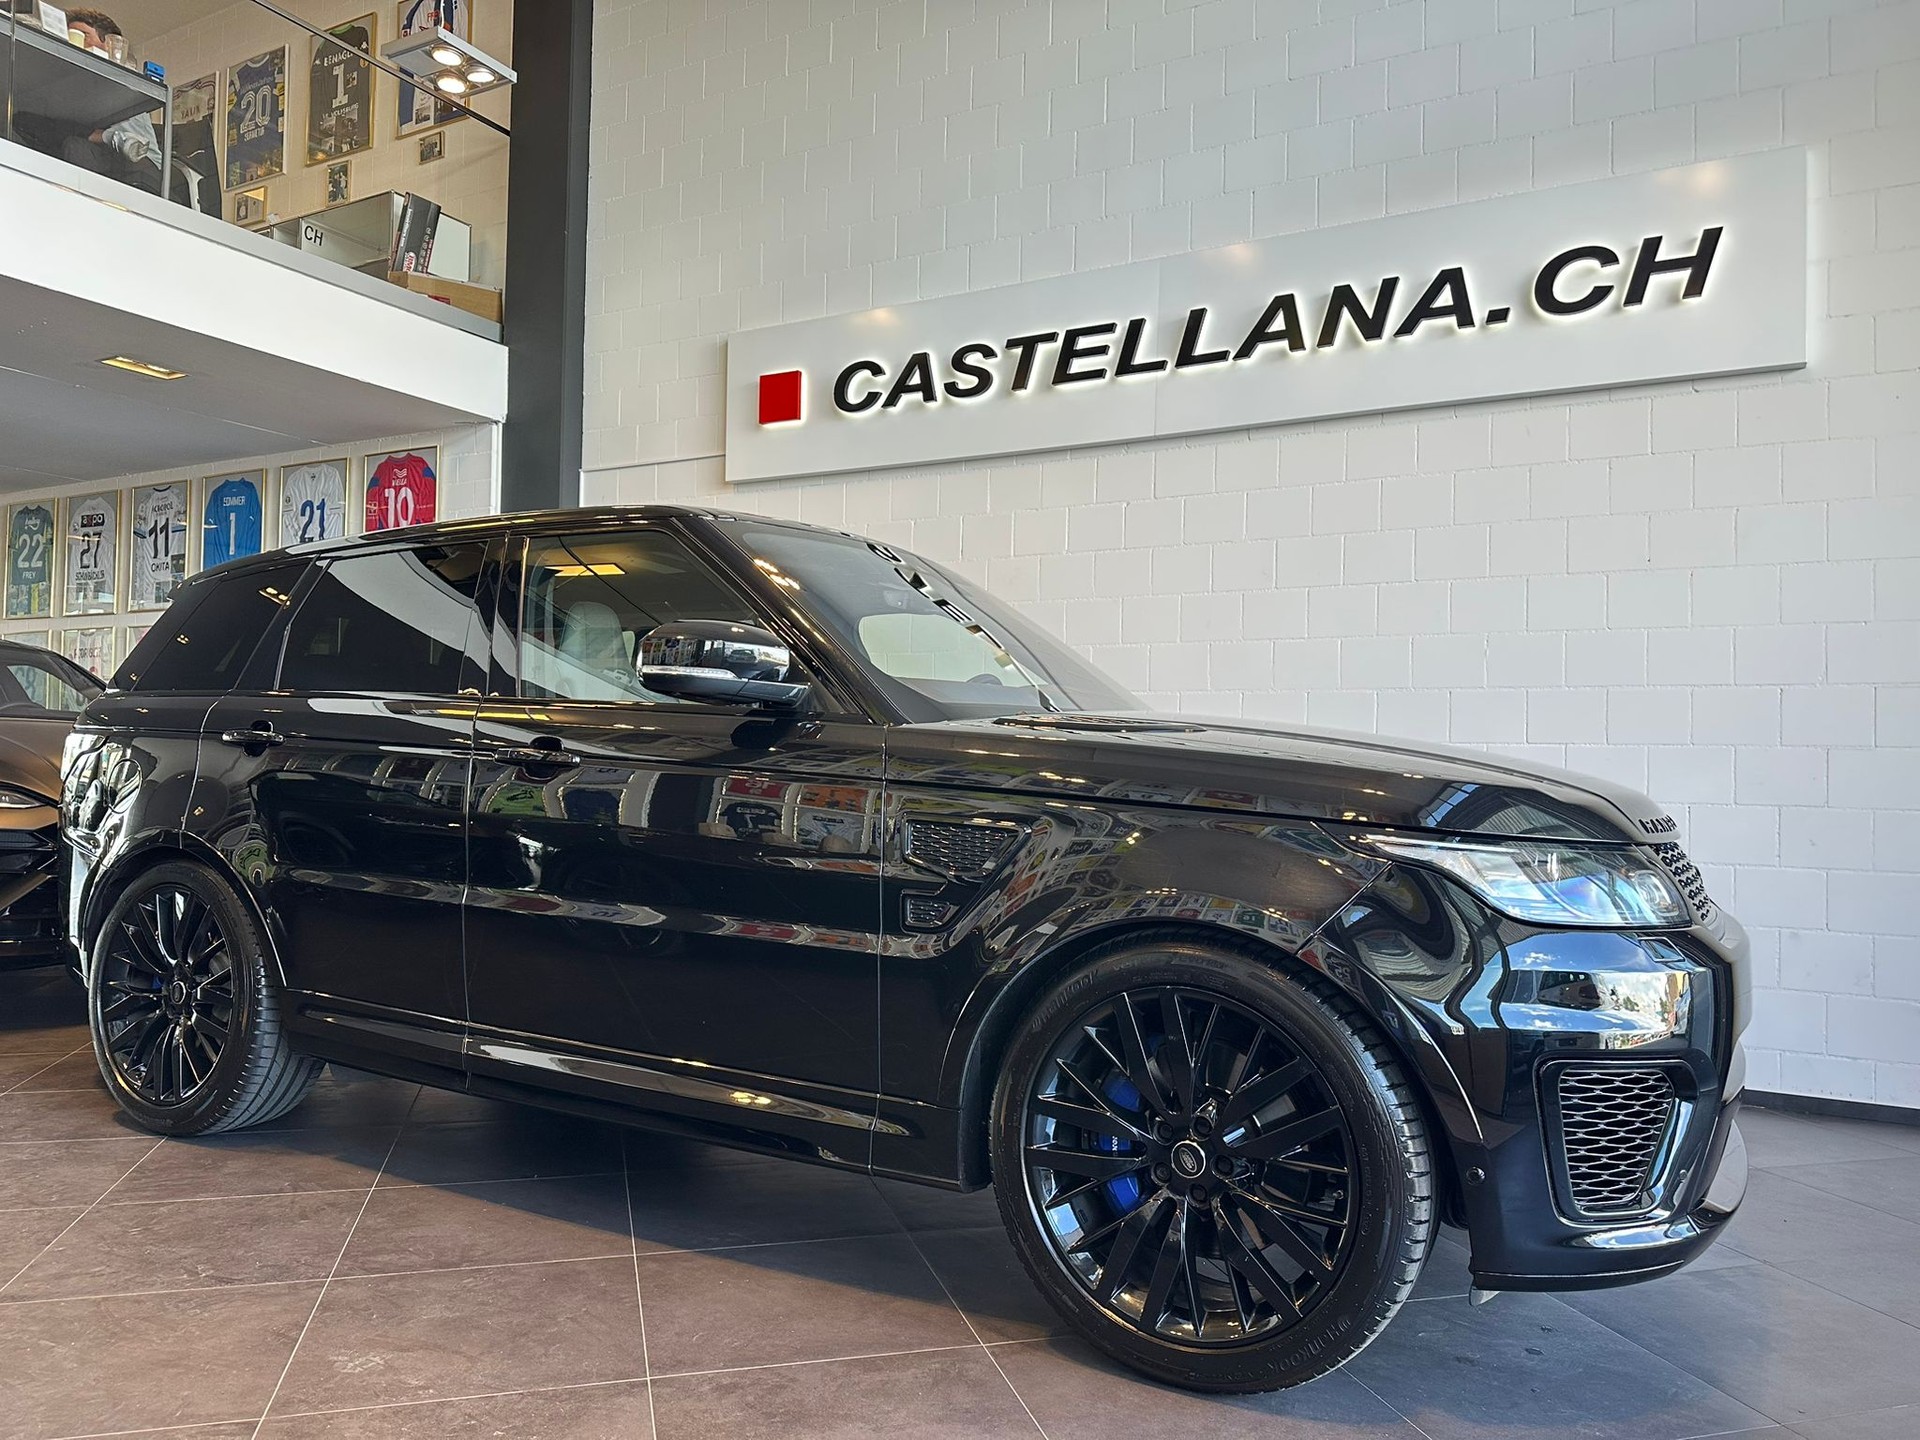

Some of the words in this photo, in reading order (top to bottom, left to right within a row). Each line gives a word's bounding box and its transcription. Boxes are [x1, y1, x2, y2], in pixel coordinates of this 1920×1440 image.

[332, 63, 349, 108] 1
[240, 84, 272, 134] 20
[304, 225, 324, 247] CH
[833, 226, 1724, 414] CASTELLANA.CH
[299, 498, 325, 543] 21
[385, 487, 415, 529] 10
[17, 533, 43, 568] 22
[80, 530, 103, 569] 27
[148, 517, 169, 559] 11
[229, 512, 236, 555] 1
